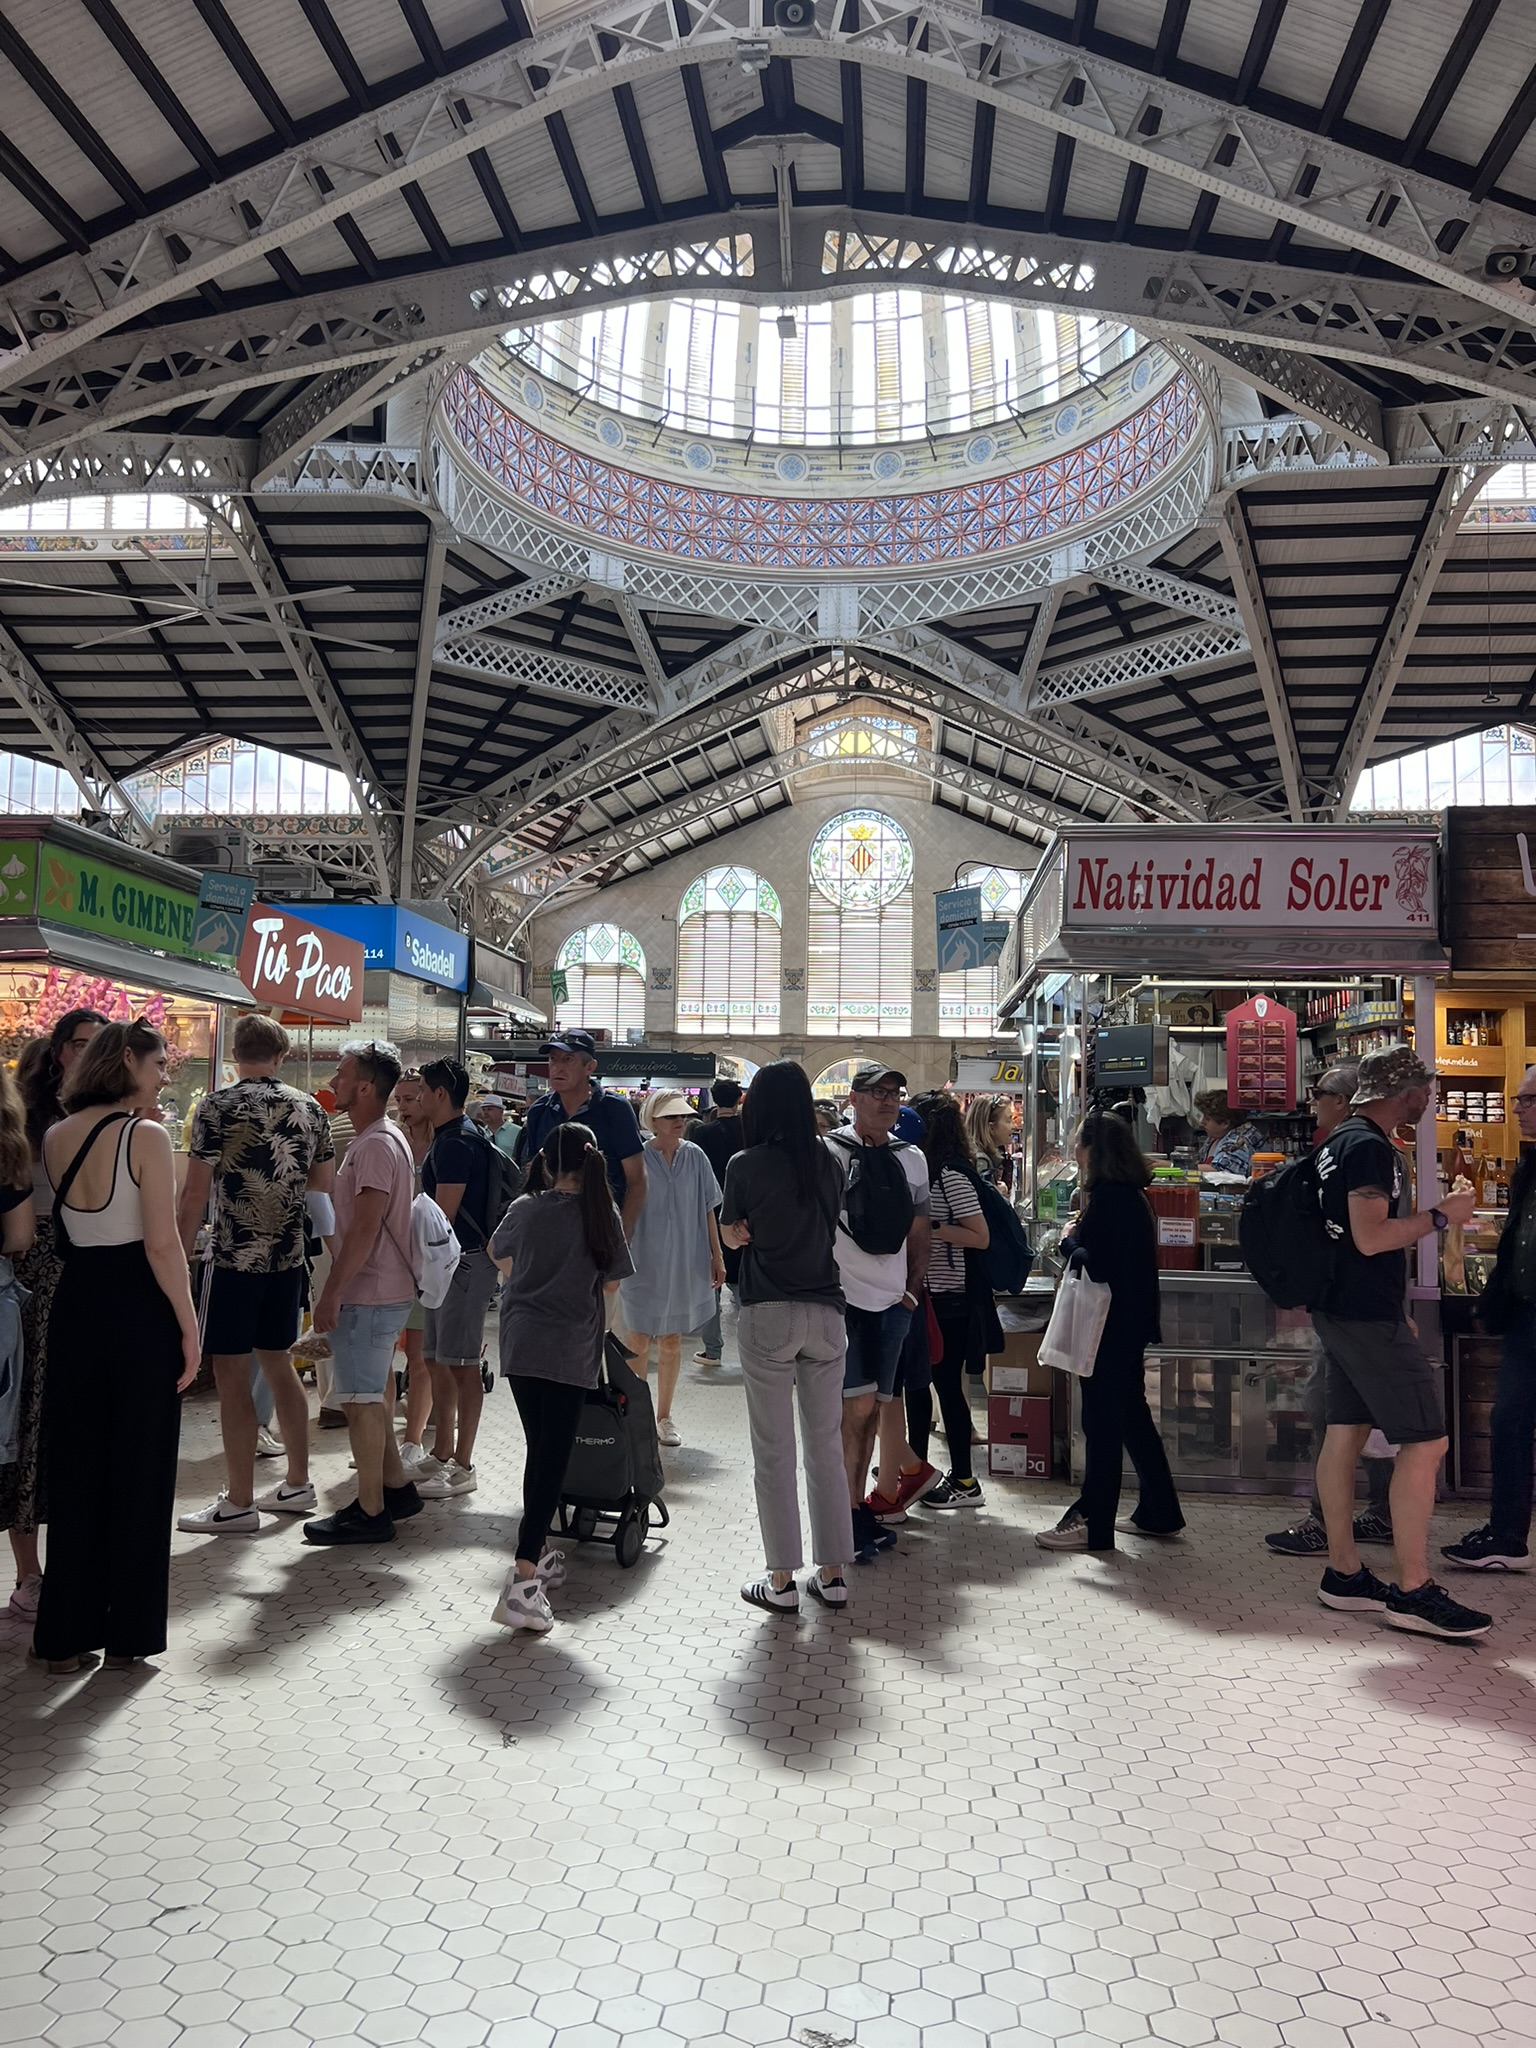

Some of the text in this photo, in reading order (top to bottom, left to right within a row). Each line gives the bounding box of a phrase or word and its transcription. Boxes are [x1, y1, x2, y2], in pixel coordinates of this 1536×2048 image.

[208, 879, 237, 892] Servei
[1073, 857, 1391, 912] Natividad Soler
[78, 870, 105, 919] M.
[938, 897, 971, 911] Servicio
[940, 909, 979, 923] domicilio
[1406, 913, 1430, 922] 411
[405, 934, 411, 948] B
[252, 917, 354, 1002] Tio Paco
[411, 937, 455, 979] Sabadell
[606, 1057, 679, 1073] charcutería
[575, 1435, 616, 1446] THERMO
